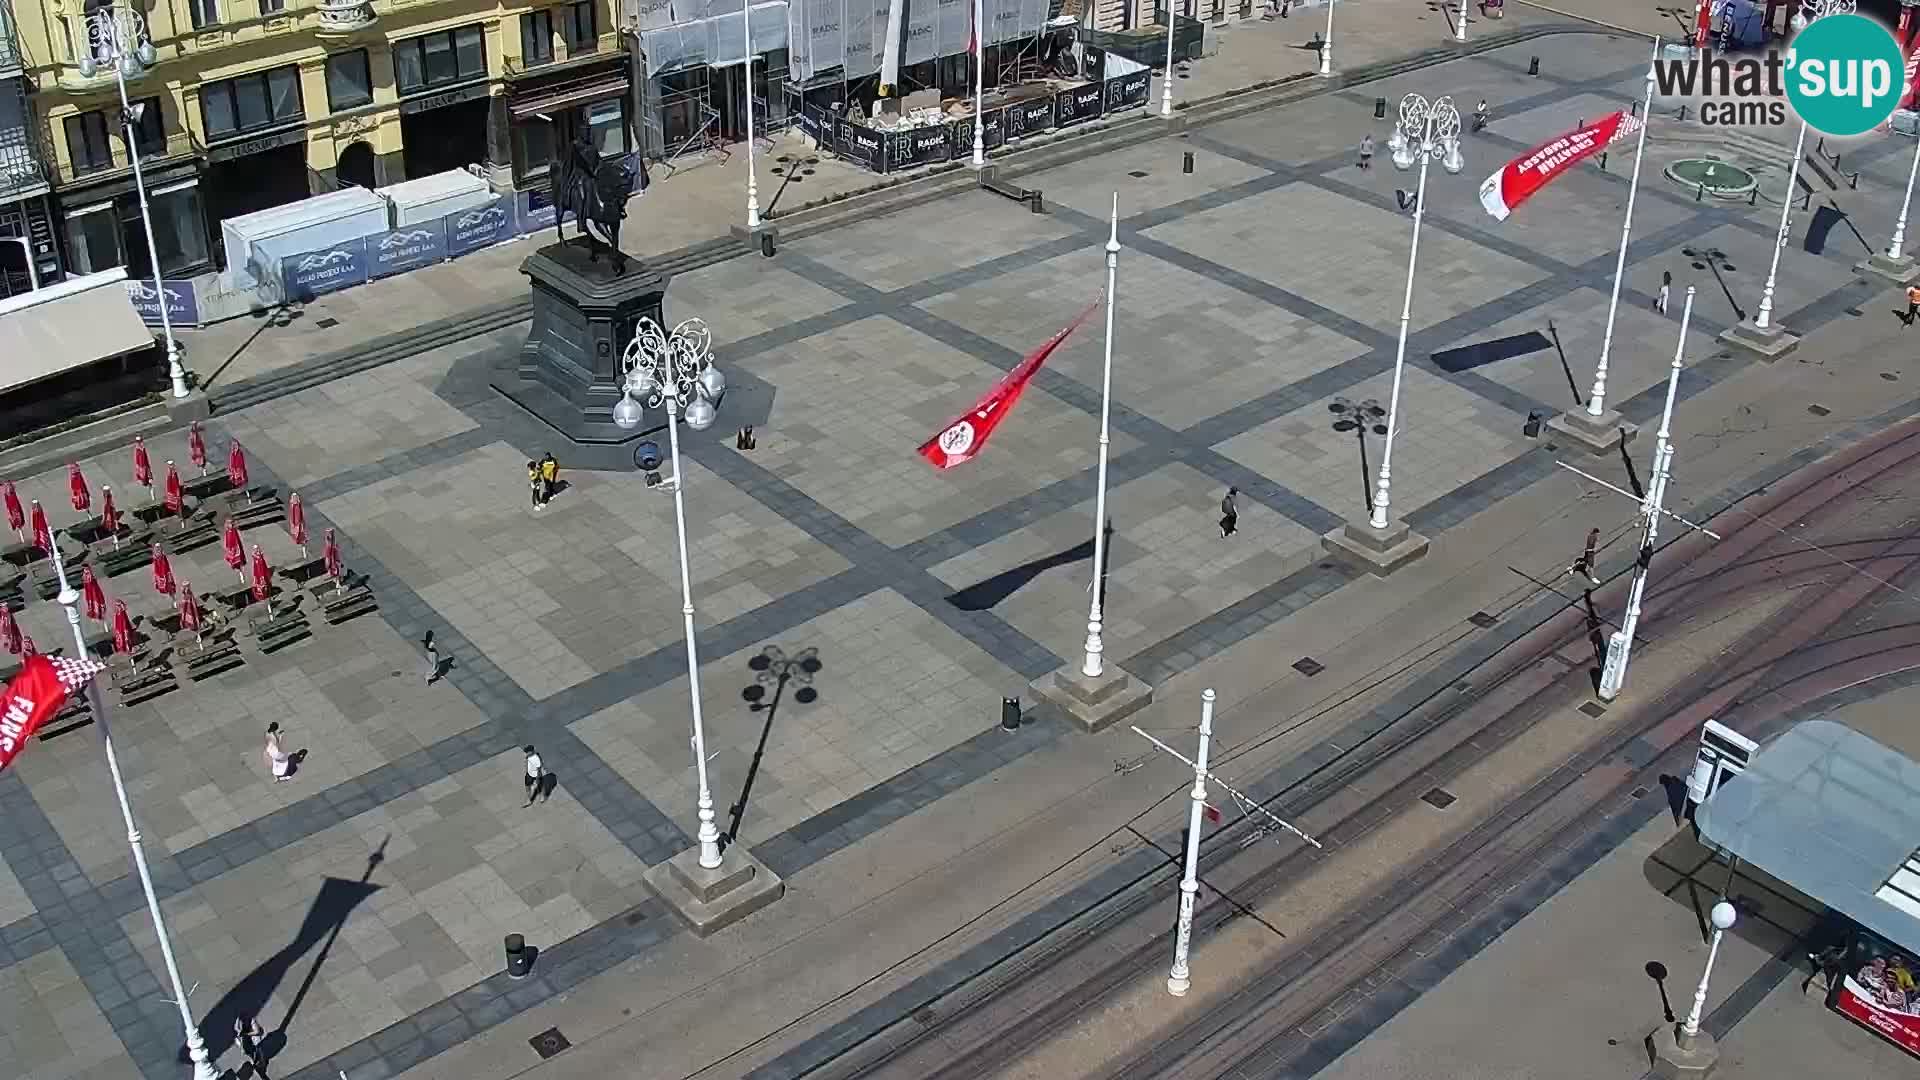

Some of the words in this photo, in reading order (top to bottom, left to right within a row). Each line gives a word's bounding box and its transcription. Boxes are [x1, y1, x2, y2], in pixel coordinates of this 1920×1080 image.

[1517, 137, 1571, 174] EMBASSY
[1537, 138, 1596, 176] CROATIAN
[0, 695, 35, 753] FANS
